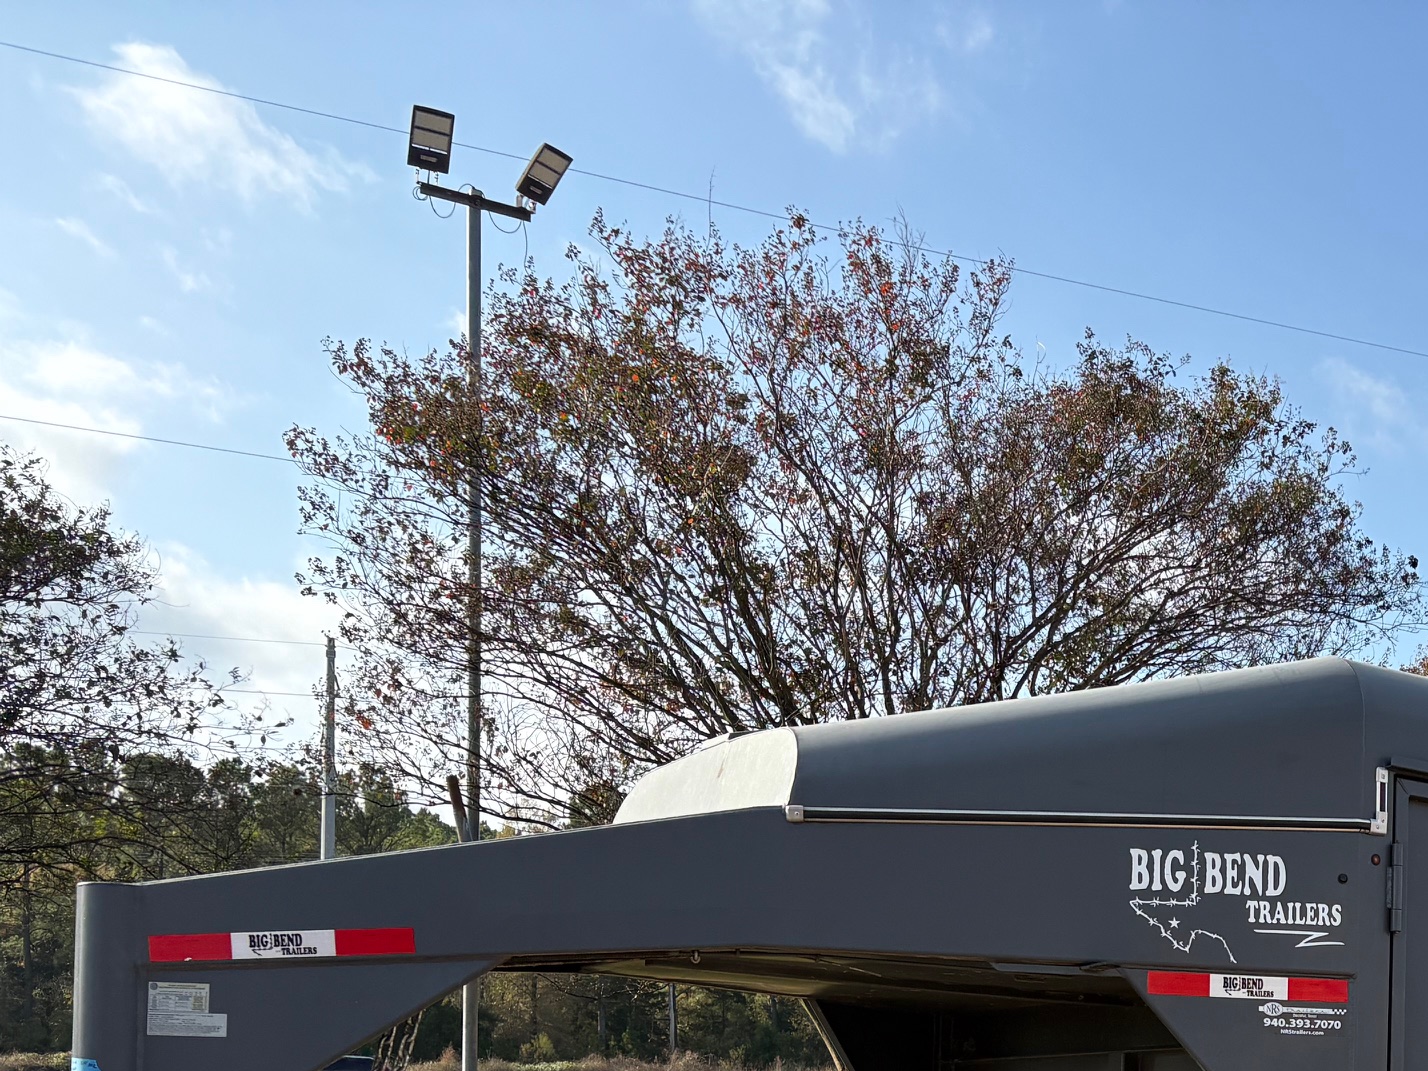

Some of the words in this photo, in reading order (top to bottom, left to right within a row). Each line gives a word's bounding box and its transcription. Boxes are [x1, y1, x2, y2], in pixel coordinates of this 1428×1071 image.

[1129, 848, 1187, 892] BIG
[1203, 852, 1287, 896] BEND
[1246, 900, 1342, 927] TRAILERS
[249, 934, 269, 948] BIG
[273, 933, 303, 948] BEND
[281, 947, 318, 956] TRAILERS
[1223, 976, 1238, 989] BIG
[1241, 978, 1264, 990] BEND
[1246, 990, 1275, 998] TRAILERS
[1266, 1003, 1281, 1015] NRS
[1263, 1017, 1342, 1030] 940.393.7070
